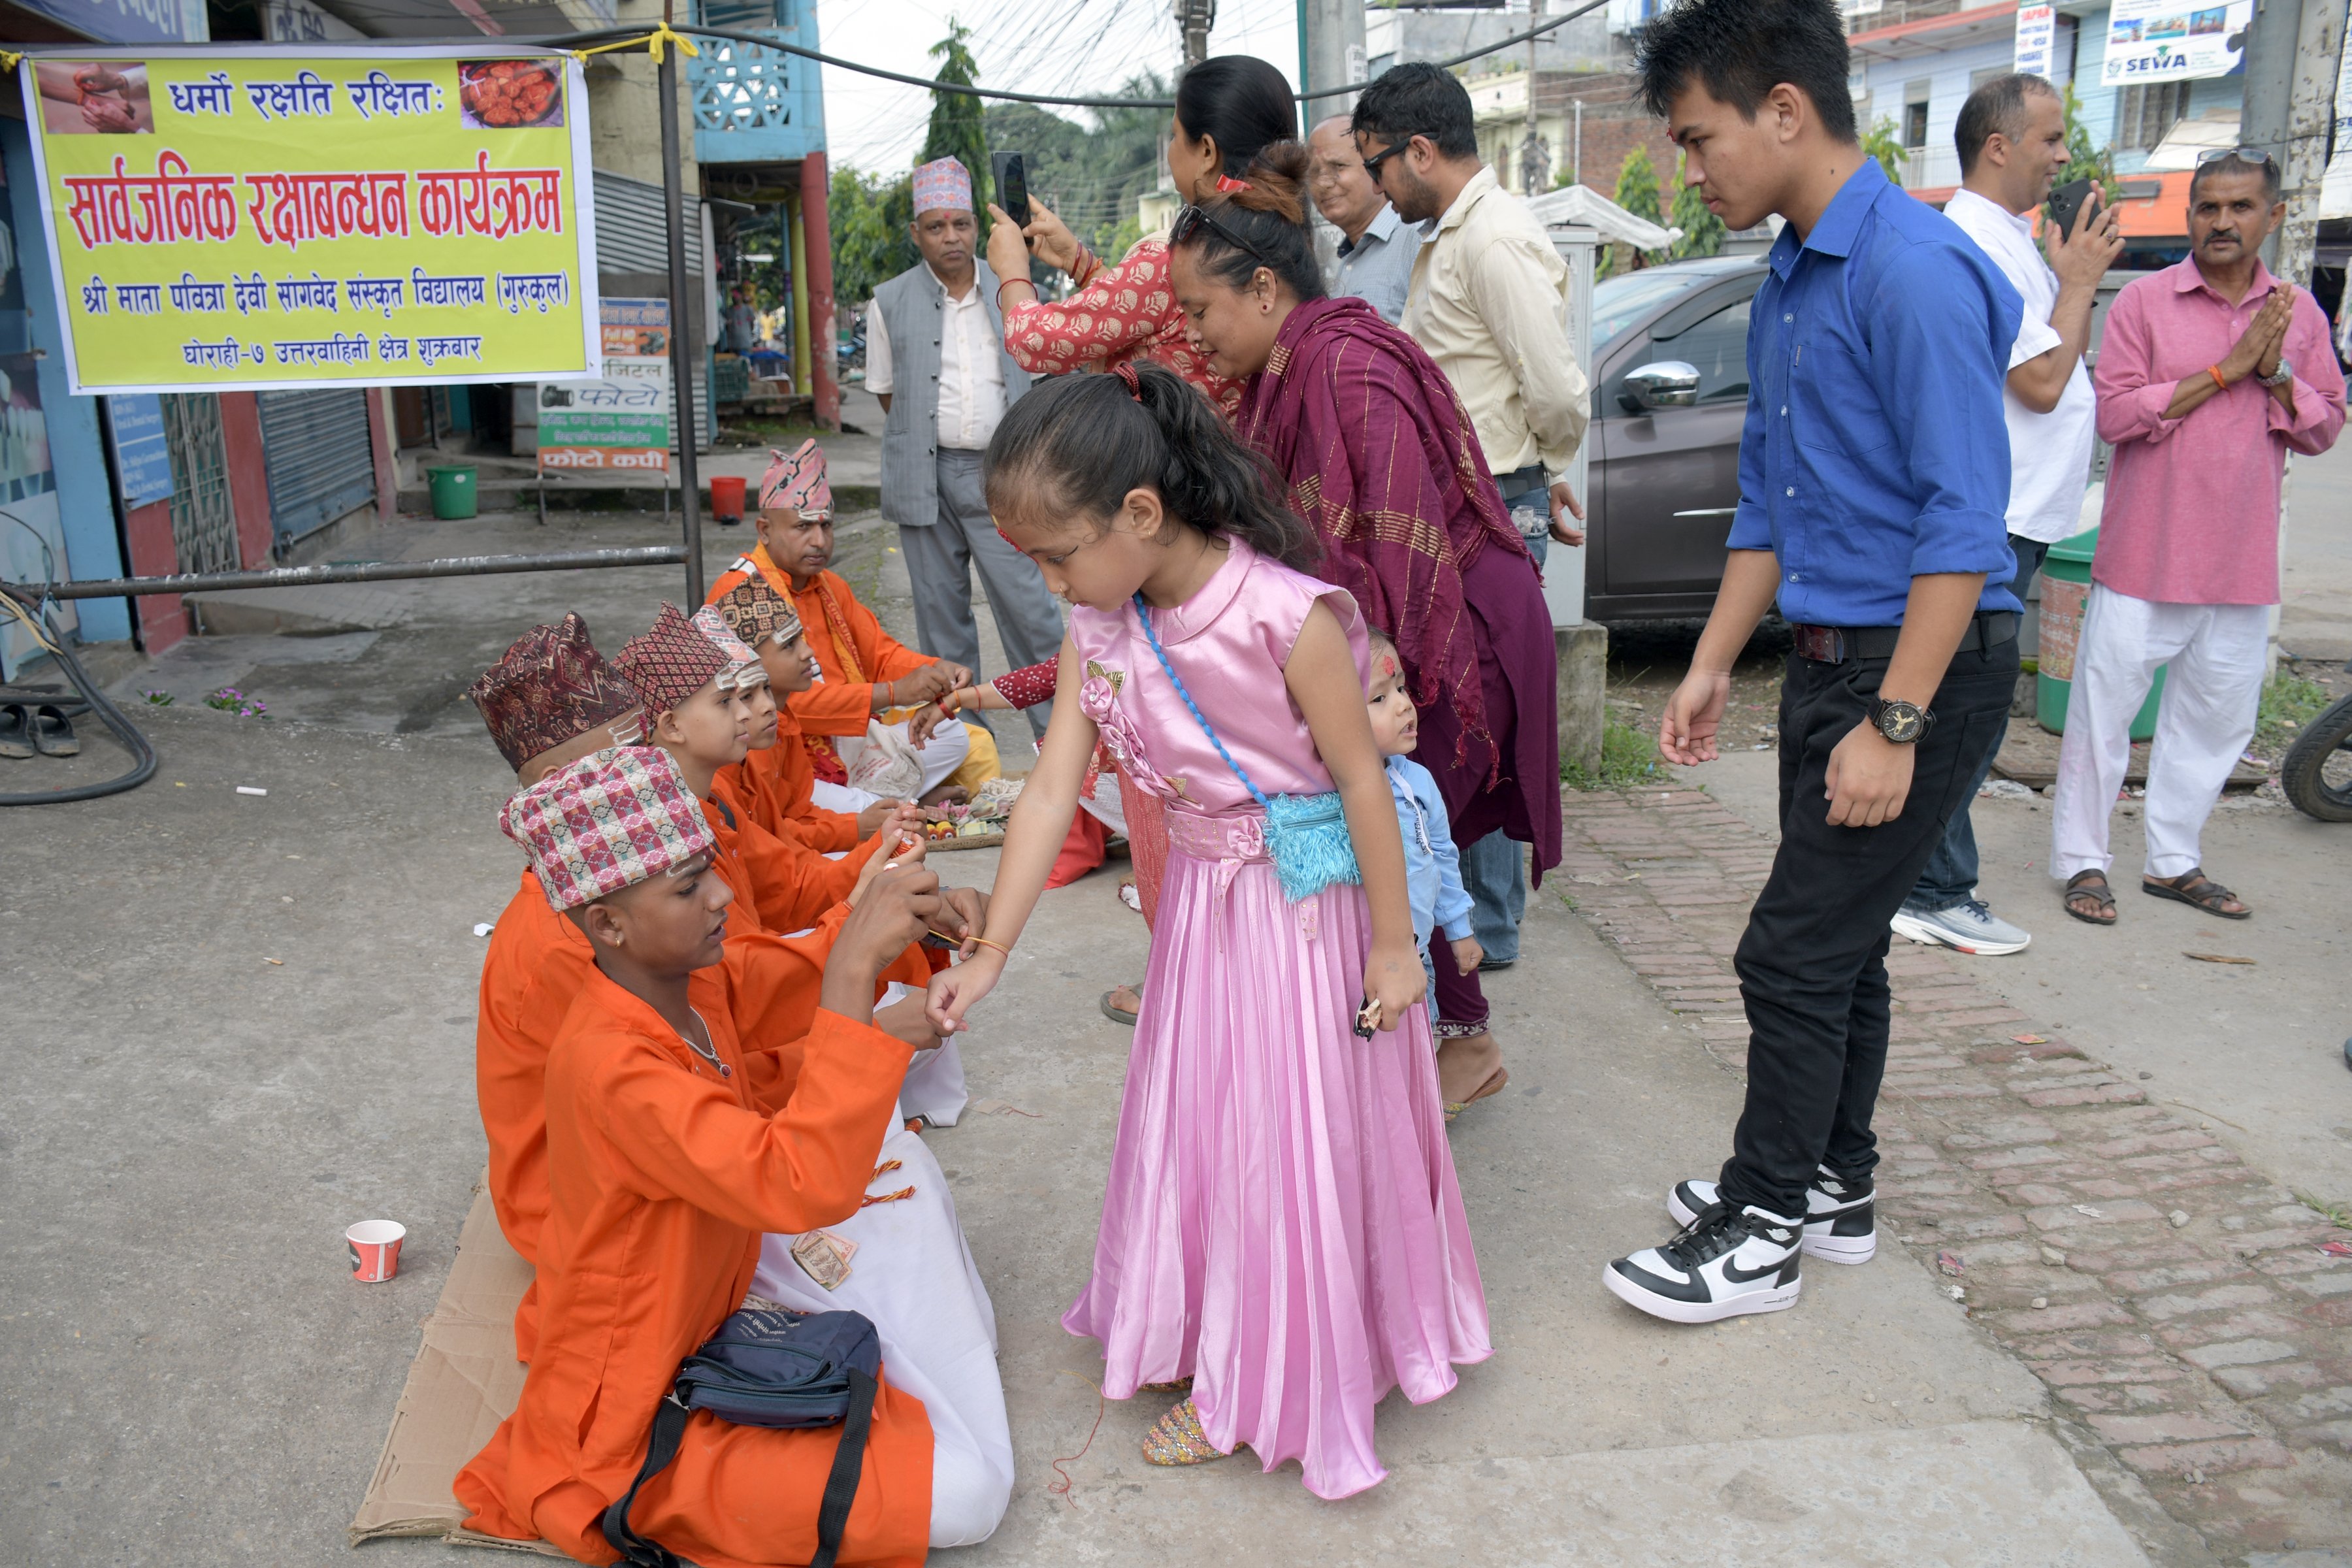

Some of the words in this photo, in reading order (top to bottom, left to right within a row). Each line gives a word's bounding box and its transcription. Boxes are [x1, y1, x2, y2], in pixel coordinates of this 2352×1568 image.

[2127, 54, 2187, 71] SEWA
[169, 73, 233, 114] धर्मो
[247, 72, 333, 119] रक्षति
[65, 151, 235, 248] सार्वजनिक
[246, 173, 408, 248] रक्षाबन्धन
[417, 152, 561, 238] कार्यक्रम
[82, 275, 108, 314] श्री
[116, 285, 161, 312] माता
[169, 273, 225, 311] पवित्रा
[234, 272, 267, 315] देवी
[276, 273, 337, 312] सांगवेद
[346, 273, 403, 318] संस्कृत
[412, 267, 485, 307] विद्यालय
[497, 270, 568, 314] (गुरुकुल)
[184, 336, 265, 368] घोराही-७
[274, 334, 369, 365] उत्तरवाहिनी
[379, 334, 408, 361] क्षेत्र
[417, 337, 482, 366] शुक्रबार
[602, 358, 662, 378] जिटल
[579, 382, 663, 406] फोटो
[544, 449, 604, 467] फोटो
[612, 450, 664, 468] कपी
